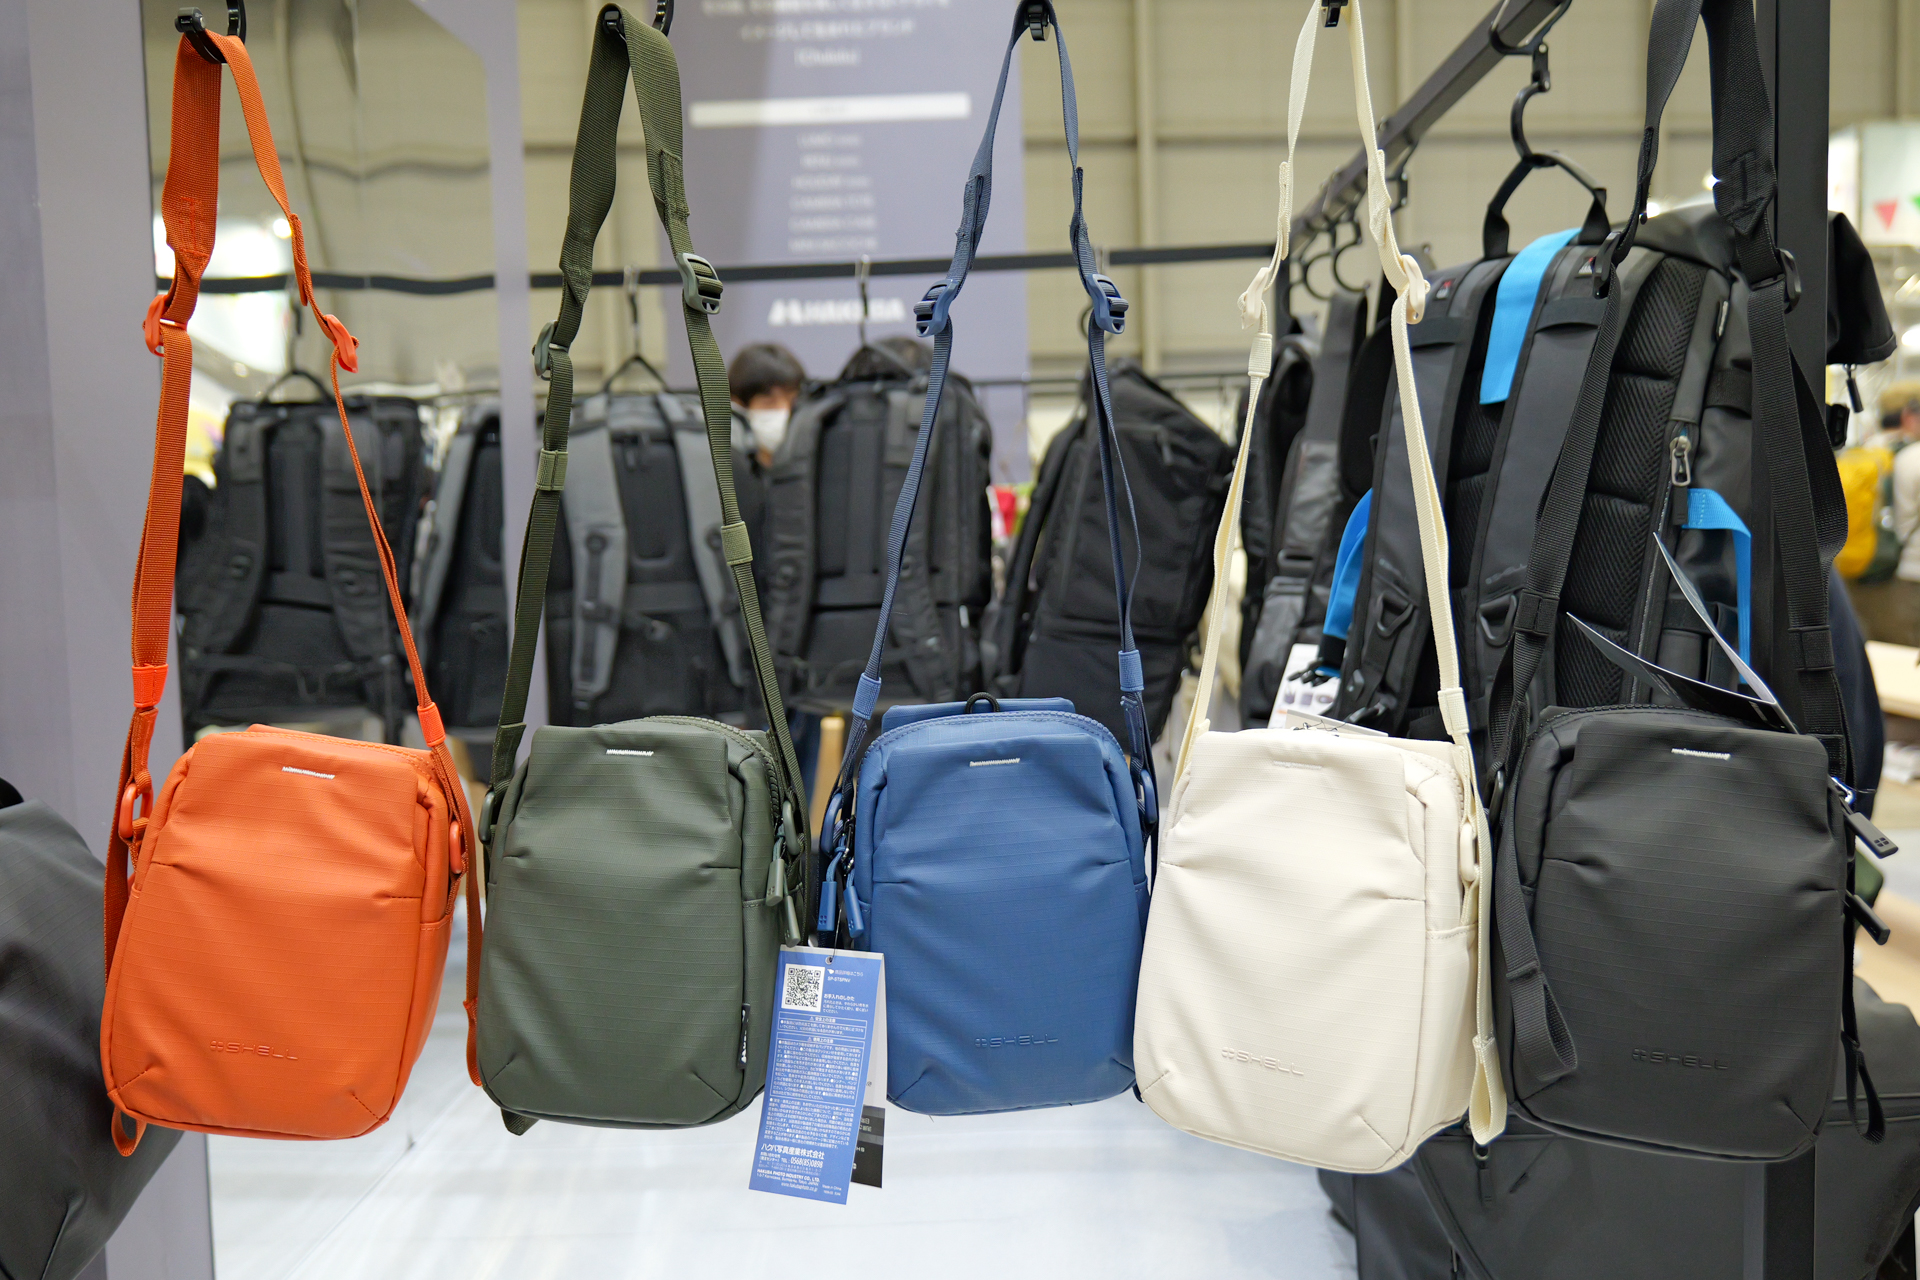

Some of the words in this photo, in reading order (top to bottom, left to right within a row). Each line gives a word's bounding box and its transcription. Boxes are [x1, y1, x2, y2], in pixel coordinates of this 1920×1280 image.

[990, 1033, 1059, 1048] SHELL
[226, 1041, 299, 1060] SHELL
[1236, 1049, 1305, 1077] SHELL
[1649, 1051, 1729, 1070] SHELL
[760, 1143, 825, 1160] ハクバ写真産業株式会社
[790, 1156, 824, 1169] 0568(85)0898
[785, 1172, 804, 1180] INDUSTRY
